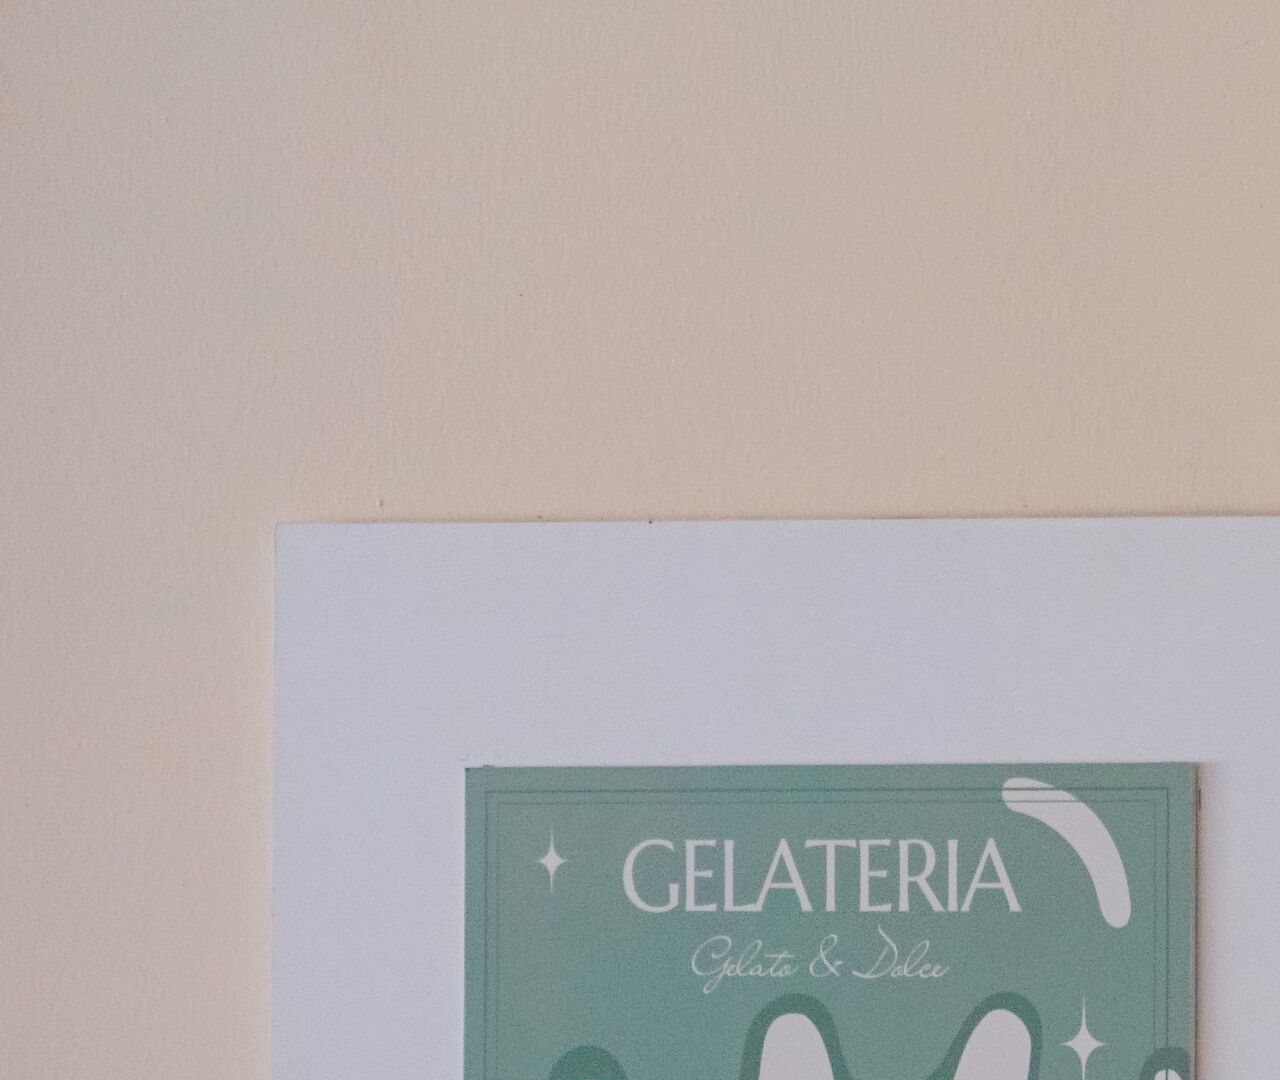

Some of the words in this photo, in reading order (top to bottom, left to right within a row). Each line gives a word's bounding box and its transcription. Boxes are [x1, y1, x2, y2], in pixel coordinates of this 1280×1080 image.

[621, 837, 1022, 914] GELATERIA
[691, 935, 799, 993] Gelato
[809, 932, 843, 979] &
[854, 924, 951, 981] Dolce
